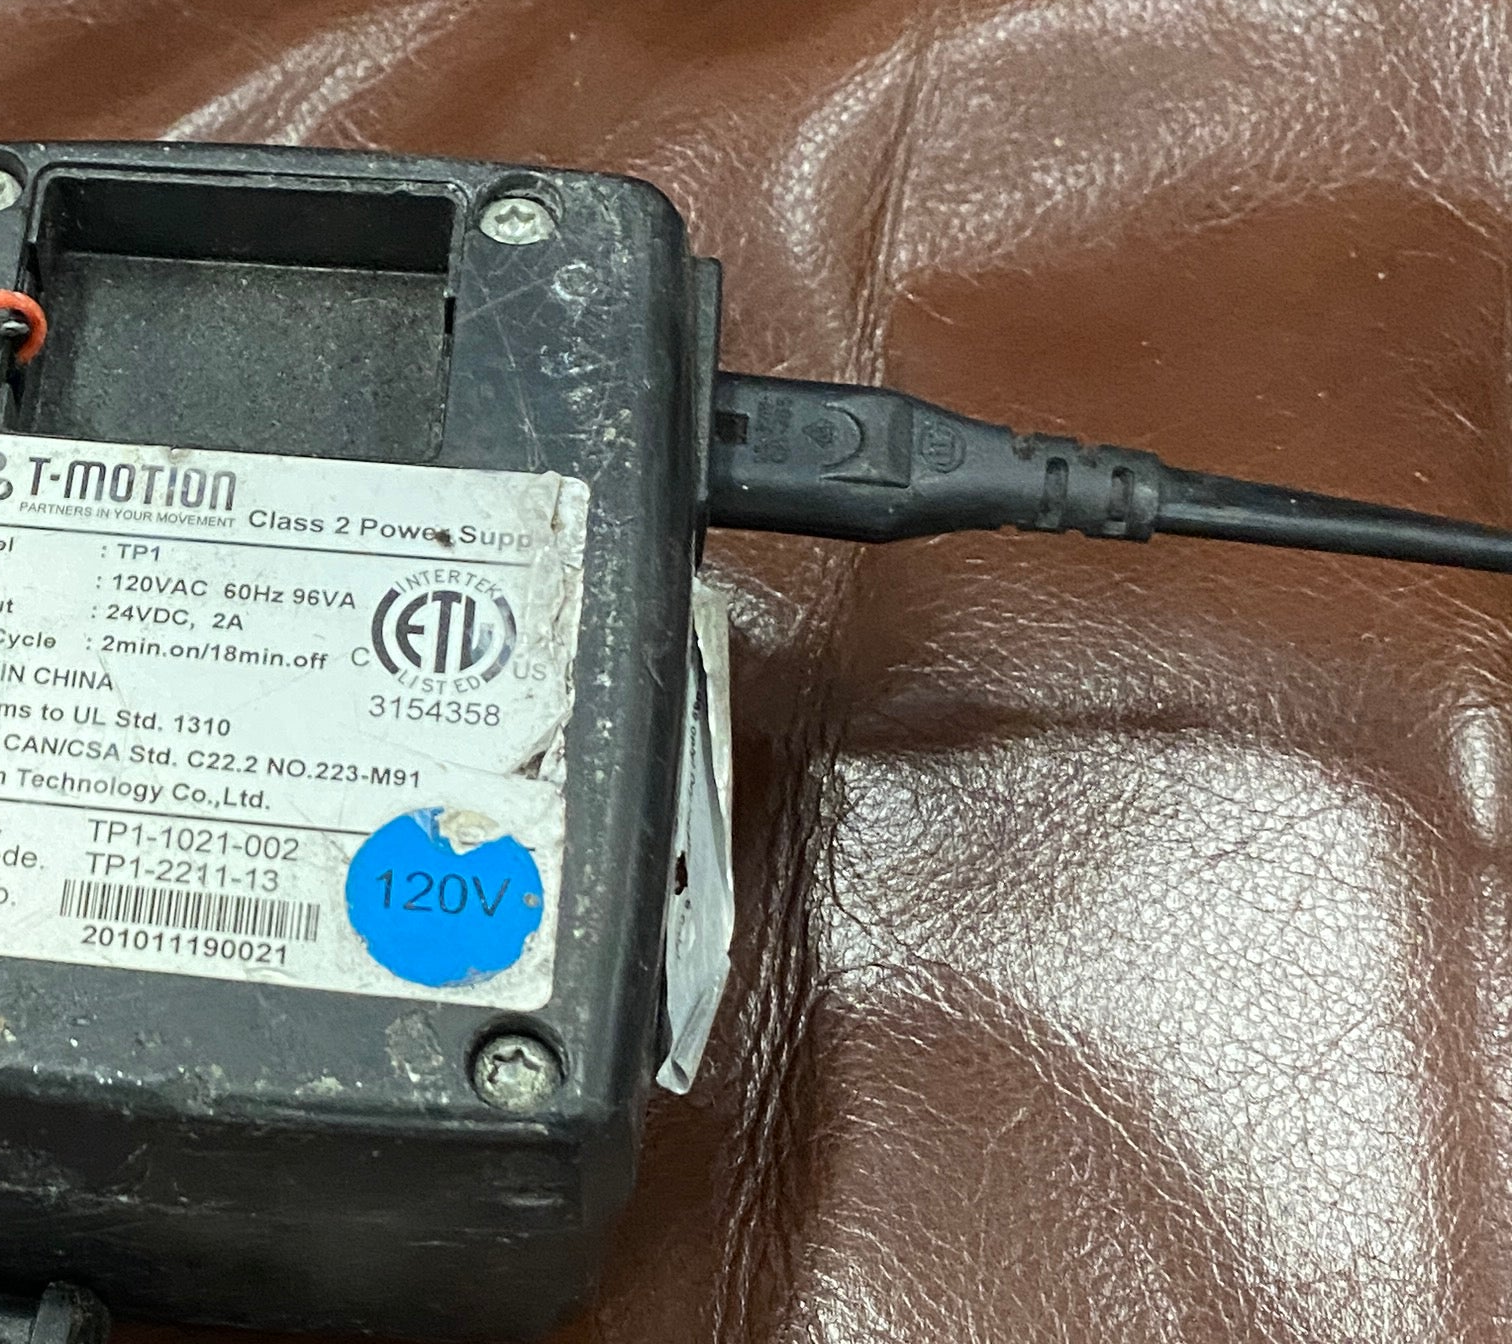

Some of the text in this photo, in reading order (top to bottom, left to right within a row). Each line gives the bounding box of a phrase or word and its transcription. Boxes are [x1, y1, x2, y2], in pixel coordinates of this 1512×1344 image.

[19, 501, 236, 528] PARTNERS IN YOUR MOVEMENT
[248, 509, 324, 534] Class
[335, 516, 351, 535] 2
[117, 543, 161, 562] TP1
[112, 574, 208, 597] 120VAC
[224, 583, 284, 604] 60Hz
[292, 588, 356, 609] 96VA
[395, 569, 502, 599] INTERTEK
[106, 604, 195, 630] 24VDC,
[212, 613, 244, 631] 2A
[101, 635, 328, 670] 2min.on/18min.off
[351, 647, 370, 667] C
[0, 663, 25, 684] IN
[33, 667, 114, 691] CHINA
[397, 668, 481, 695] LISTED
[512, 661, 547, 681] US
[41, 703, 64, 722] to
[73, 706, 106, 726] UL
[115, 710, 164, 731] Std.
[174, 715, 231, 736] 1310
[368, 695, 501, 727] 3154358
[3, 733, 120, 761] CAN/CSA
[129, 745, 177, 766] Std.
[187, 750, 258, 774] C22.2
[267, 757, 420, 788] NO.223-M91
[17, 768, 163, 803] Technology
[172, 783, 270, 809] Co.,Ltd.
[88, 818, 300, 861] TP1-1021-002
[86, 852, 279, 892] TP1-2211-13
[376, 869, 511, 917] 120V
[81, 925, 287, 966] 201011190021
